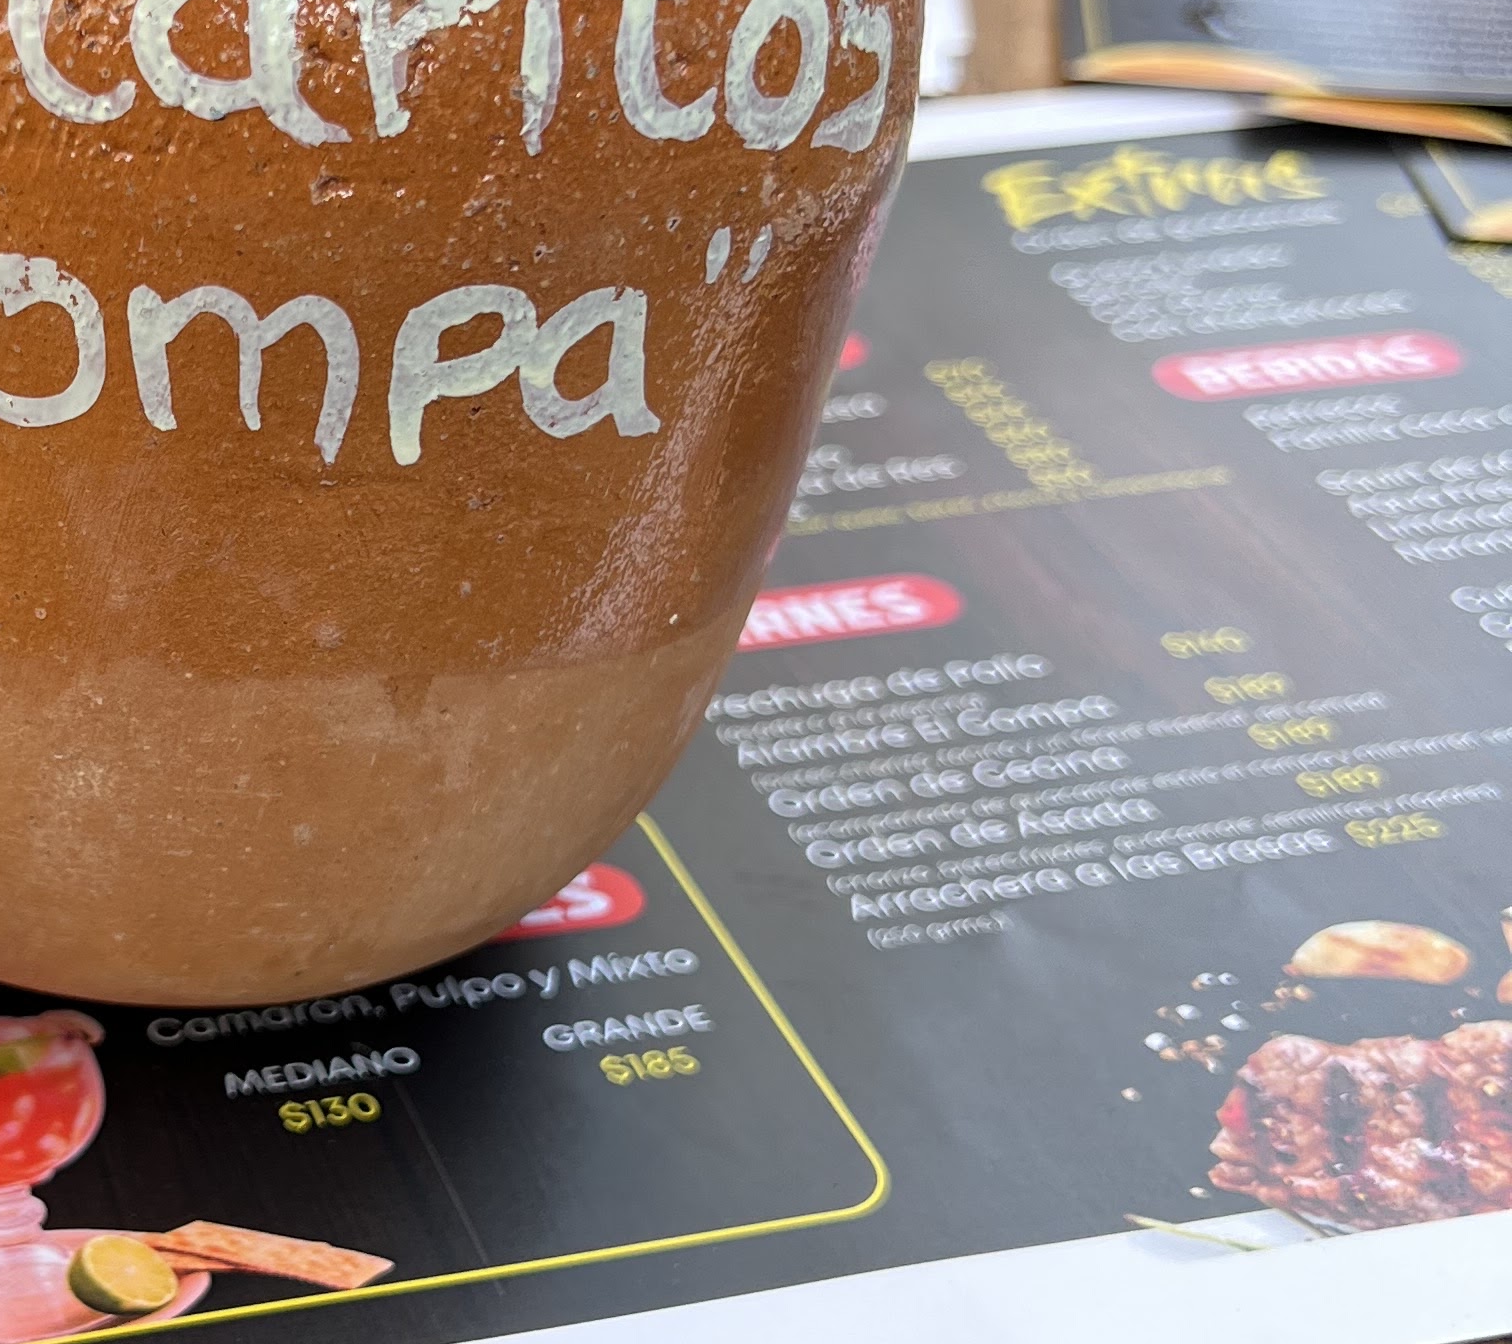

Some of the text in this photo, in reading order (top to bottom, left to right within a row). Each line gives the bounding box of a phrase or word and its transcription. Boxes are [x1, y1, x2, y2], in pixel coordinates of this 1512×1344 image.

[1179, 333, 1438, 395] BEBIDAS
[768, 776, 909, 818] Orden
[805, 827, 948, 869] Orden
[851, 866, 1077, 922] Arrachera
[389, 972, 528, 1014] Pulpo
[528, 965, 561, 1000] y
[567, 947, 701, 989] Mixto
[224, 1003, 716, 1100] MEDIANO GRANDE
[278, 1044, 701, 1135] $130 $185
